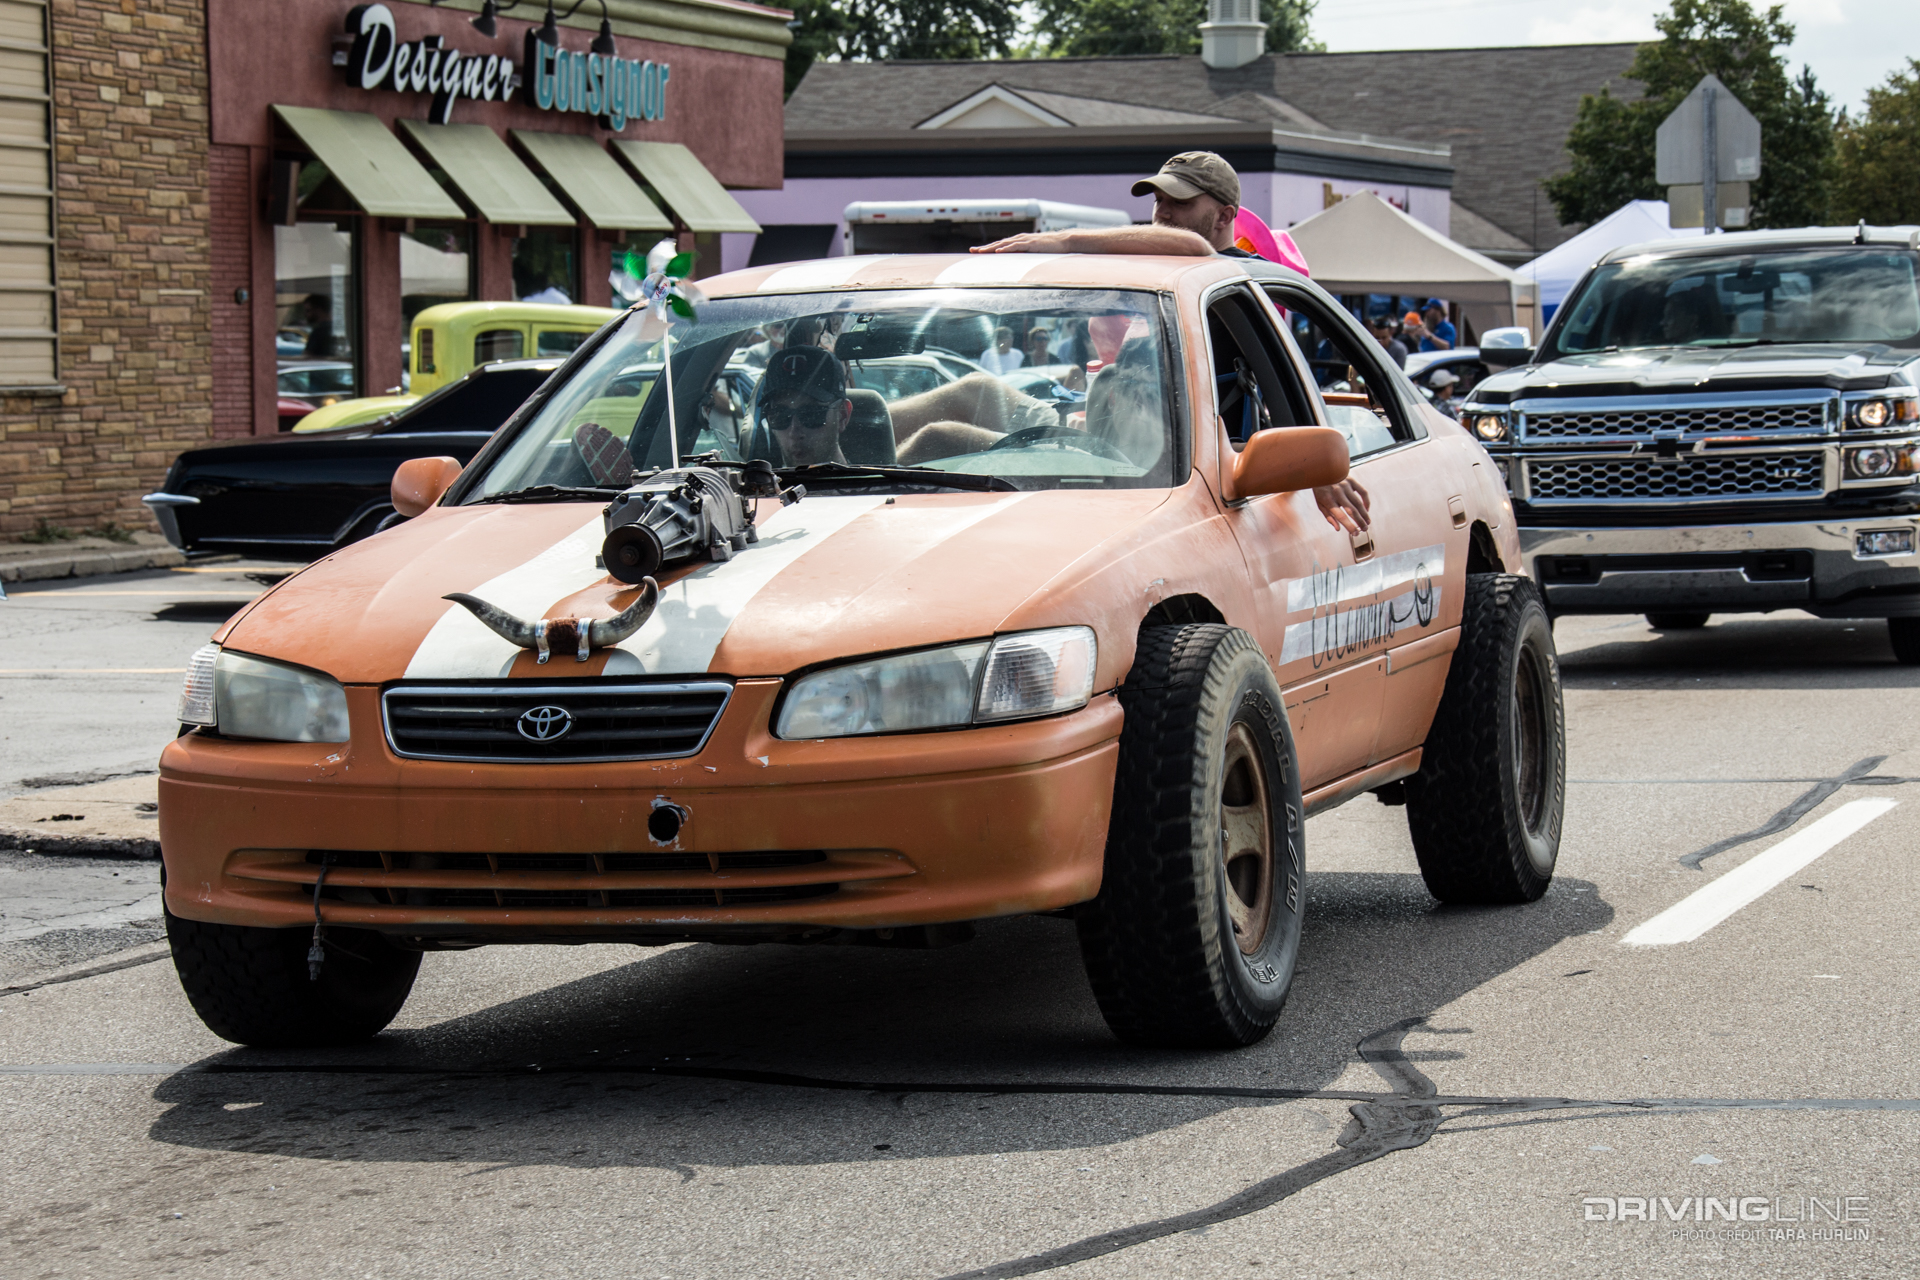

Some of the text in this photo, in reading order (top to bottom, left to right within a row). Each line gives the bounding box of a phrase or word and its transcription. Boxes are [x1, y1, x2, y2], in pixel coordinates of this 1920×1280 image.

[361, 3, 671, 132] Designer Consignor
[1774, 467, 1803, 478] LTZ
